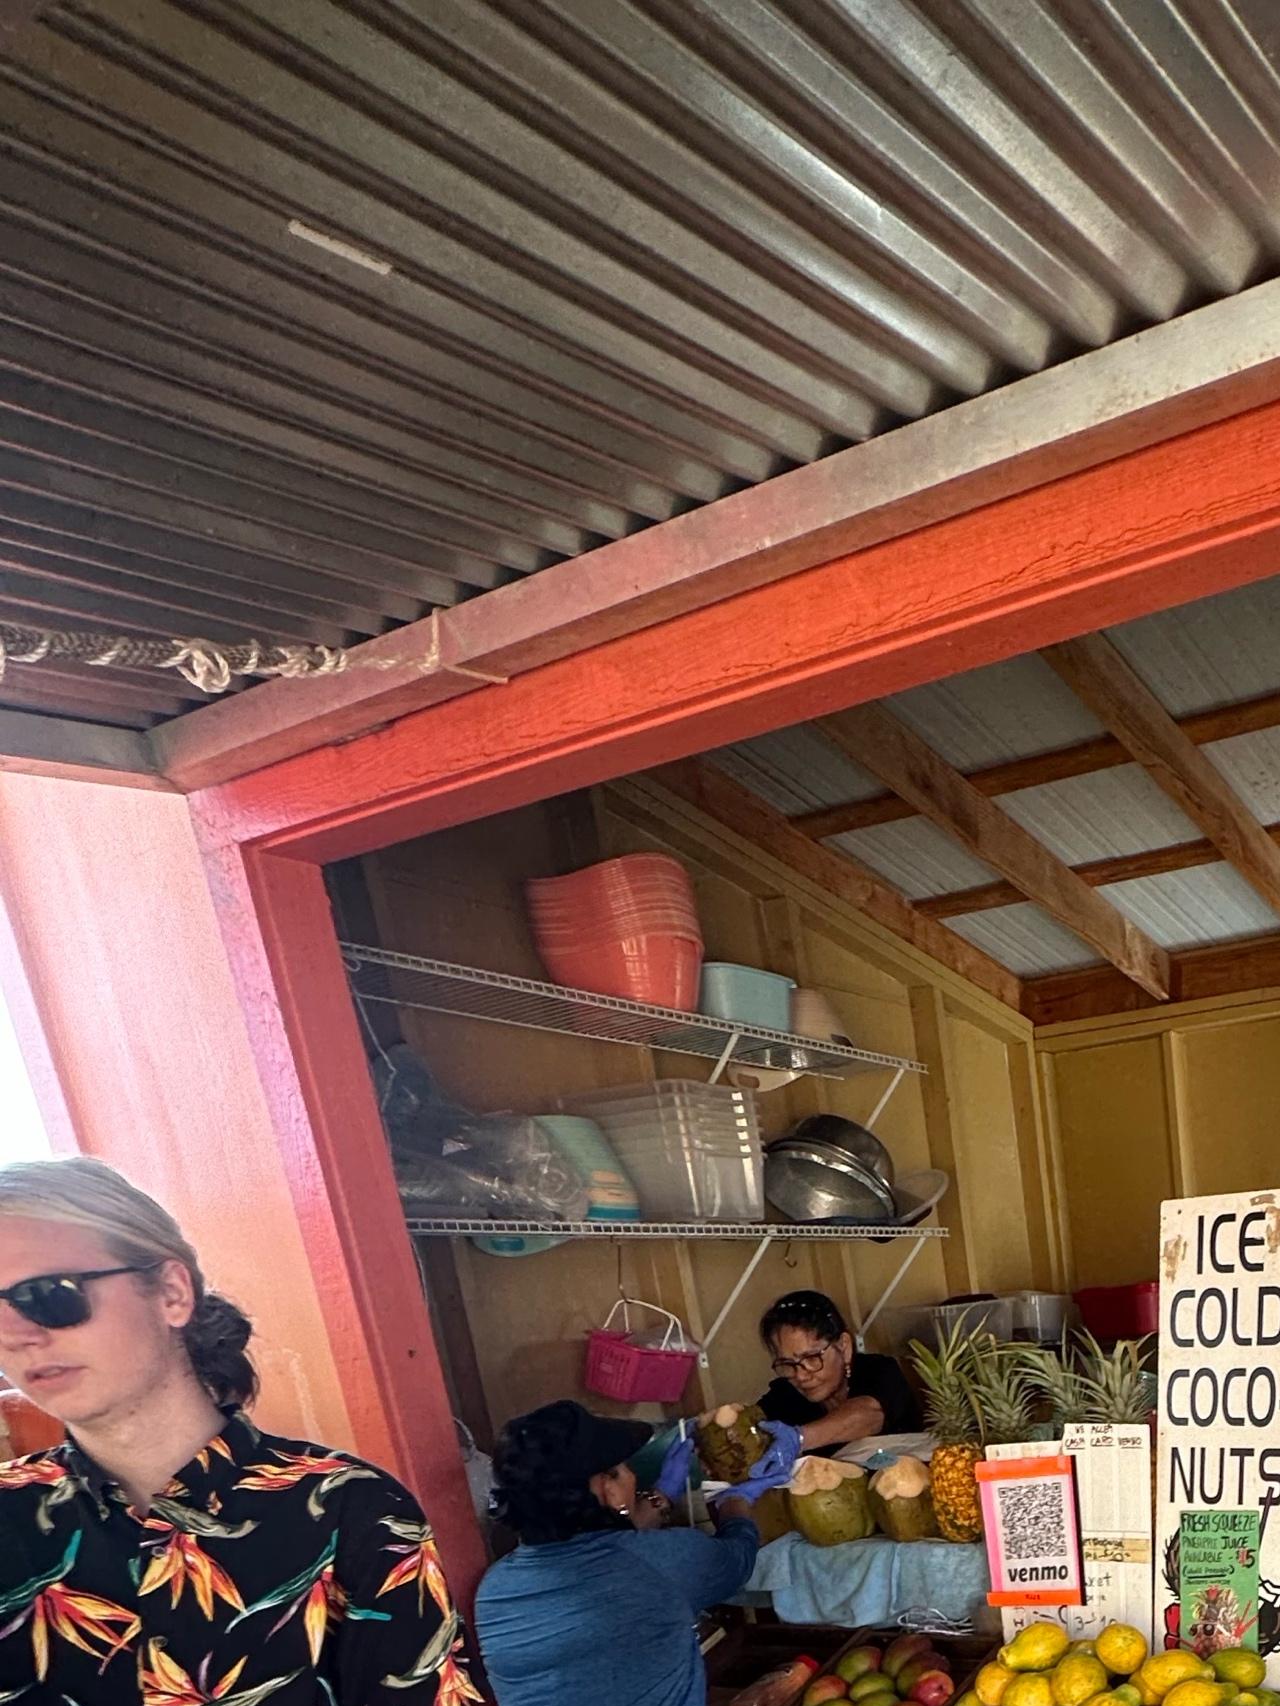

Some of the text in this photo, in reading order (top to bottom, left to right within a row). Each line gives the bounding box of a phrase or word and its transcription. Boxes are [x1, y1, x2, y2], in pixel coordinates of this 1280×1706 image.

[1197, 1211, 1266, 1275] ICE
[1181, 1513, 1210, 1533] FRESH
[1221, 1536, 1249, 1549] JUICE
[1008, 1565, 1068, 1582] venmo
